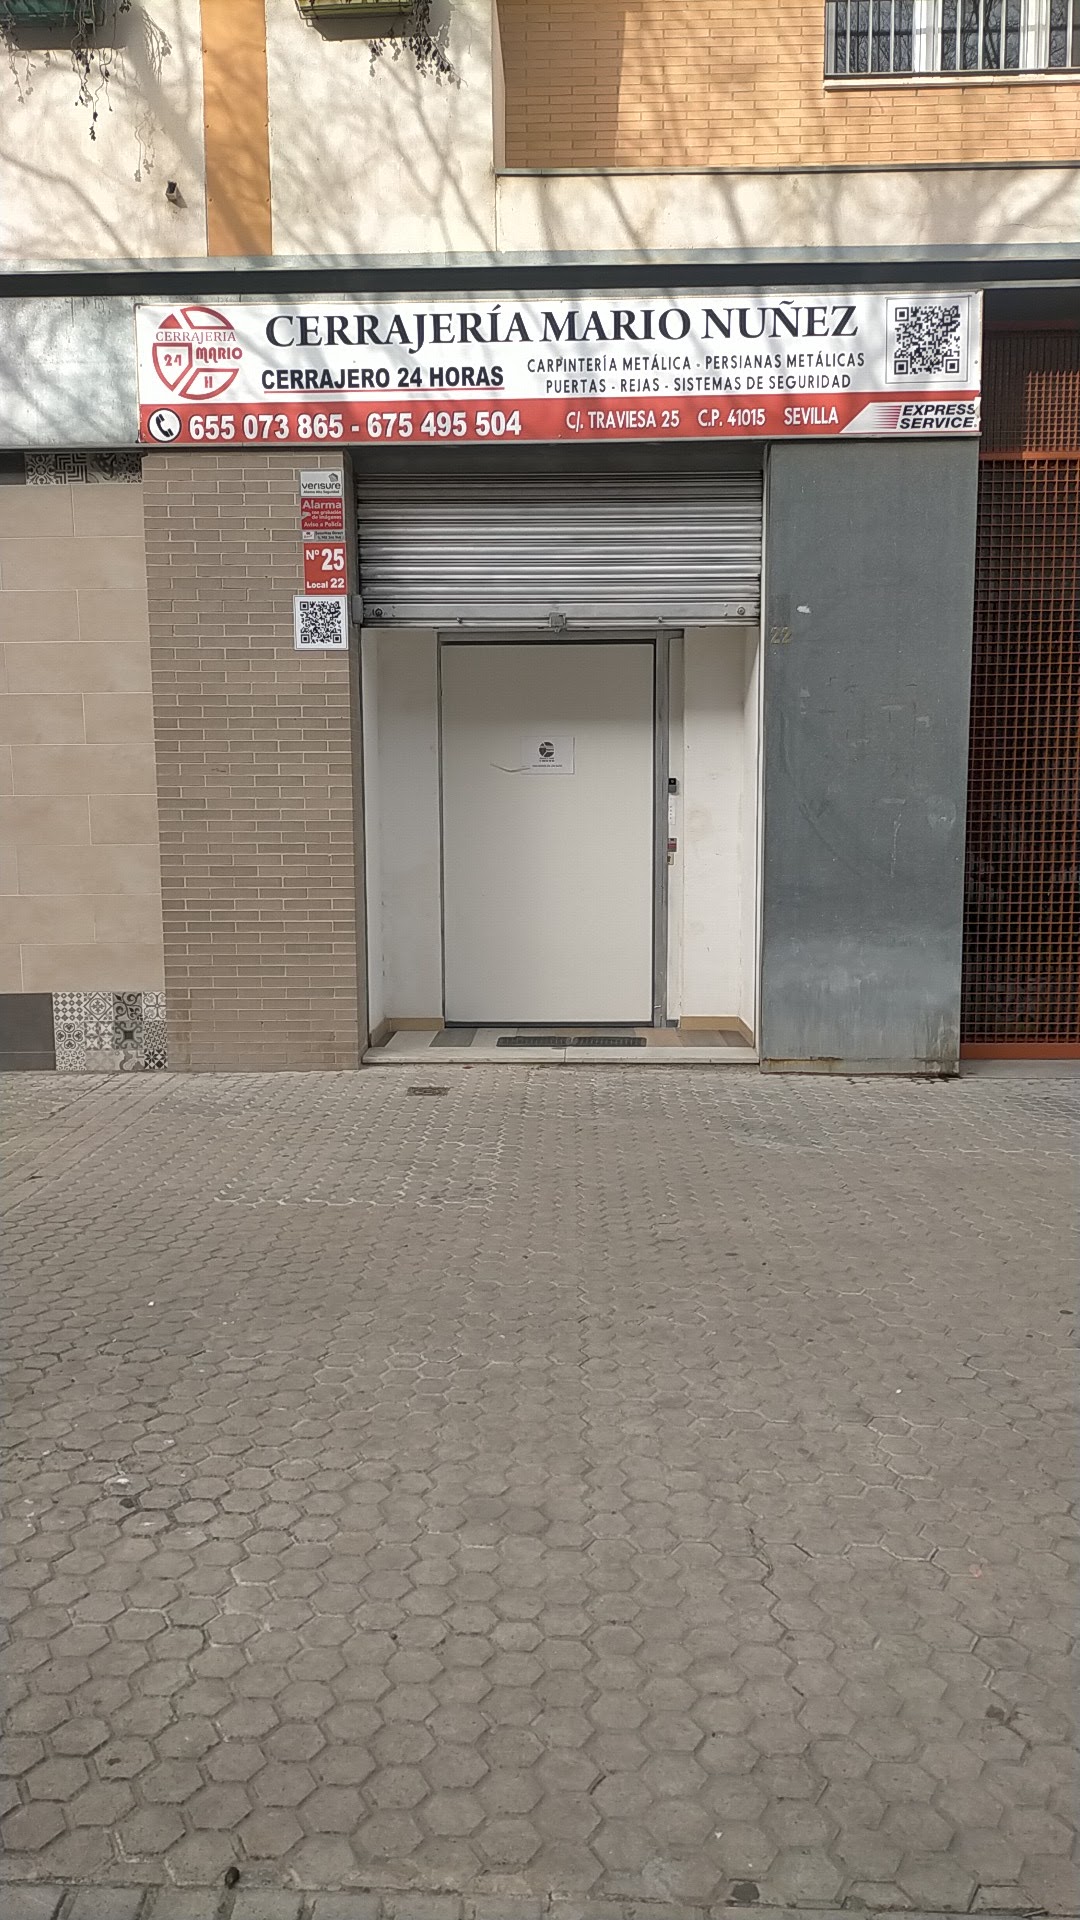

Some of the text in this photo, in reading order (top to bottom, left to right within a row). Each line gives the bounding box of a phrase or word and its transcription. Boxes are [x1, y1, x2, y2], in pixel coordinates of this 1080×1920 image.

[265, 300, 859, 355] CERRAJERÍA MARIO NUÑEZ
[155, 331, 237, 344] CERRAJERIA
[164, 354, 182, 367] 24
[196, 347, 243, 363] MARIO
[527, 354, 618, 373] CARPINTERÍA
[622, 353, 692, 371] METÁLICA
[705, 354, 781, 371] PERSIANAS
[786, 350, 865, 368] METÁLICAS
[262, 365, 504, 390] CERRAJERO 24 HORAS
[545, 378, 607, 394] PUERTAS
[619, 377, 661, 393] REJAS
[674, 376, 742, 392] SISTEMAS
[746, 375, 764, 391] DE
[768, 374, 851, 390] SEGURIDAD
[587, 410, 656, 429] TRAVIESA
[660, 409, 680, 428] 25
[697, 407, 766, 427] C.P. 41015
[784, 406, 839, 425] SEVILLA
[902, 403, 976, 416] EXPRESS
[189, 414, 235, 440] 655
[243, 414, 289, 439] 073
[297, 413, 344, 439] 865
[367, 412, 413, 438] 675
[420, 411, 468, 437] 495
[475, 410, 522, 436] 504
[302, 482, 341, 490] verisure
[302, 499, 342, 509] Alarma
[321, 548, 345, 571] 25
[306, 577, 345, 589] Local 22
